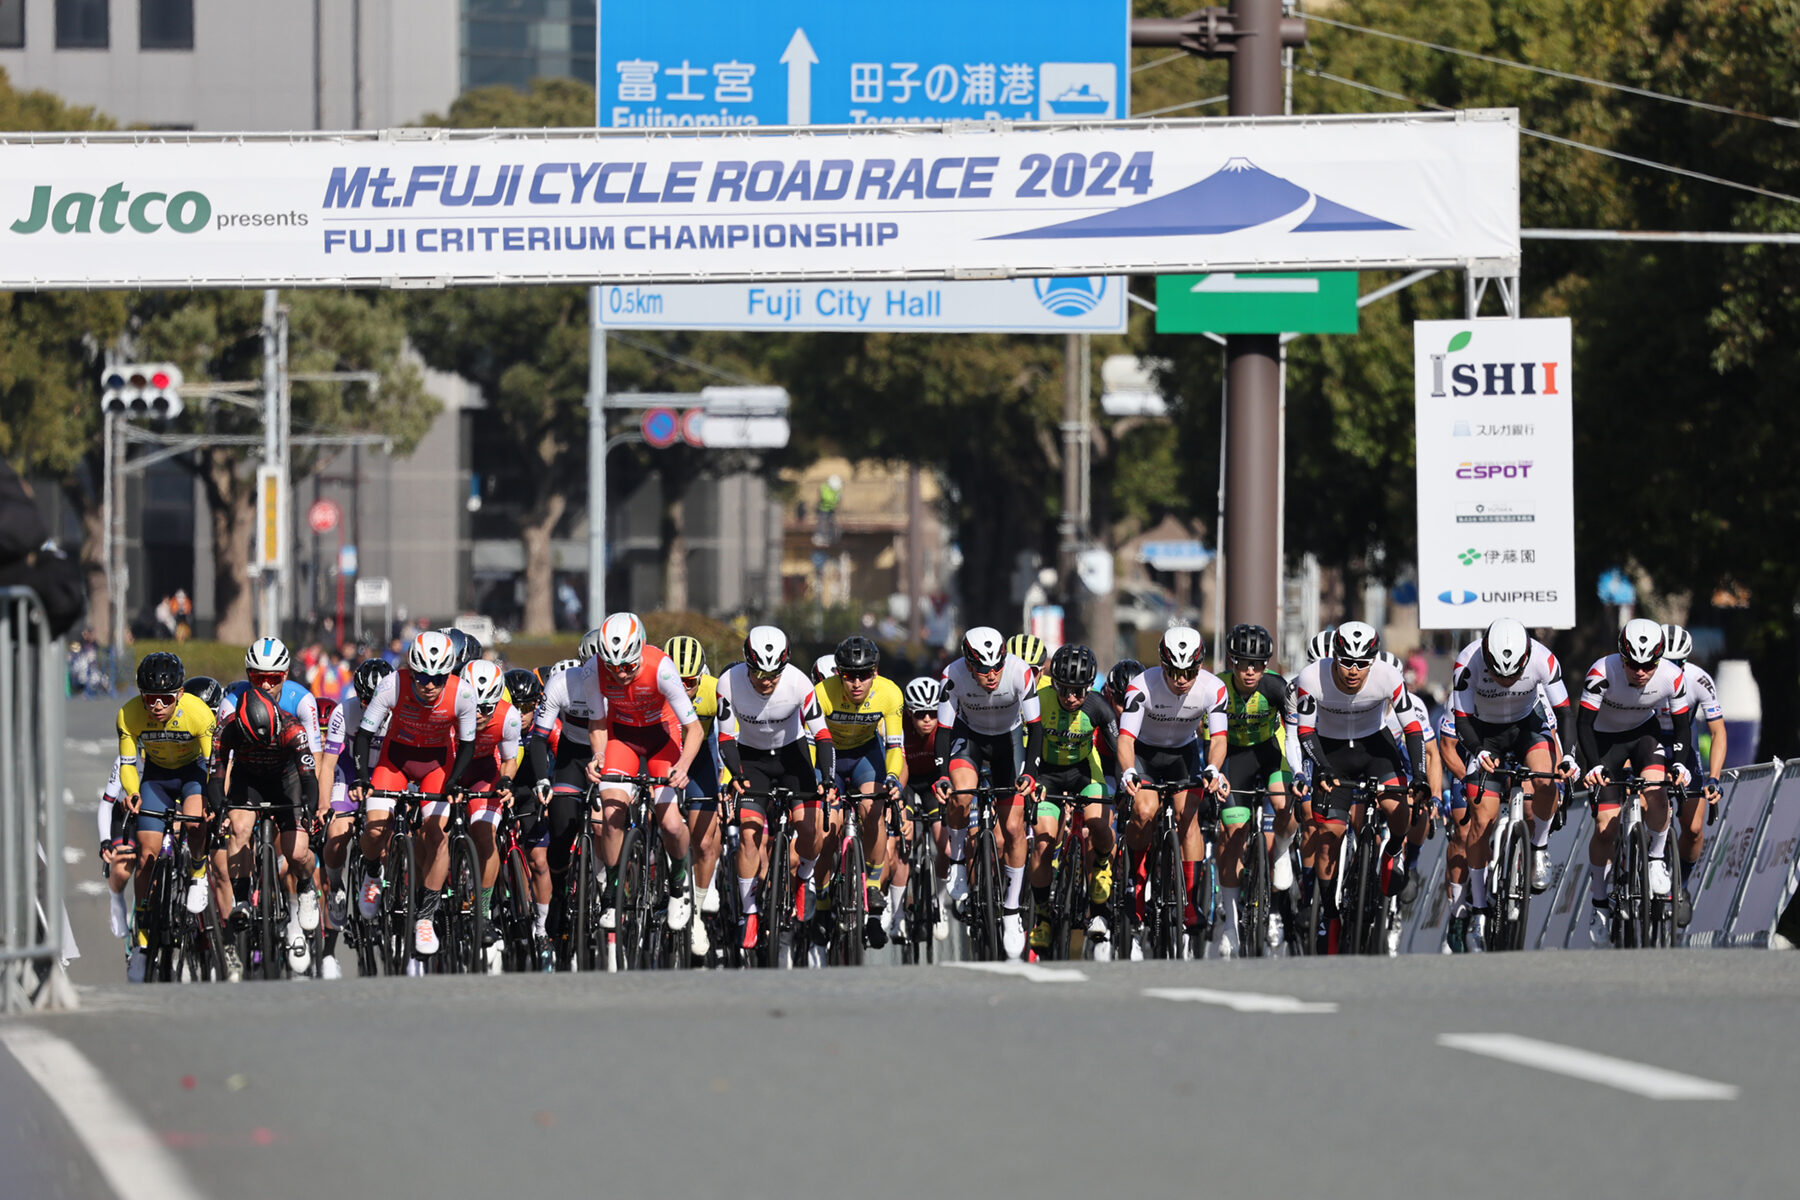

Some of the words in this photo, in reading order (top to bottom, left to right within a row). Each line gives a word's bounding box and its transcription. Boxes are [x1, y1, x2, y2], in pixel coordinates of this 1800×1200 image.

[616, 58, 756, 103] 富士宮
[850, 62, 1036, 106] 田子の浦港
[528, 161, 703, 206] CYCLE
[707, 158, 855, 203] ROAD
[856, 156, 1000, 201] RACE
[1015, 151, 1154, 198] 2024
[10, 181, 213, 234] Jatco
[216, 210, 309, 231] presents
[324, 228, 405, 254] FUJI
[416, 224, 614, 252] CRITERIUM
[624, 221, 899, 250] CHAMPIONSHIP
[609, 285, 663, 316] 0.5km
[747, 288, 802, 322] Fuji
[815, 288, 872, 322] City
[886, 288, 941, 317] Hall
[1430, 353, 1559, 397] ISHII
[1476, 424, 1535, 437] スルガ銀行
[1484, 549, 1536, 564] 伊藤園
[1481, 590, 1558, 603] UNIPRES
